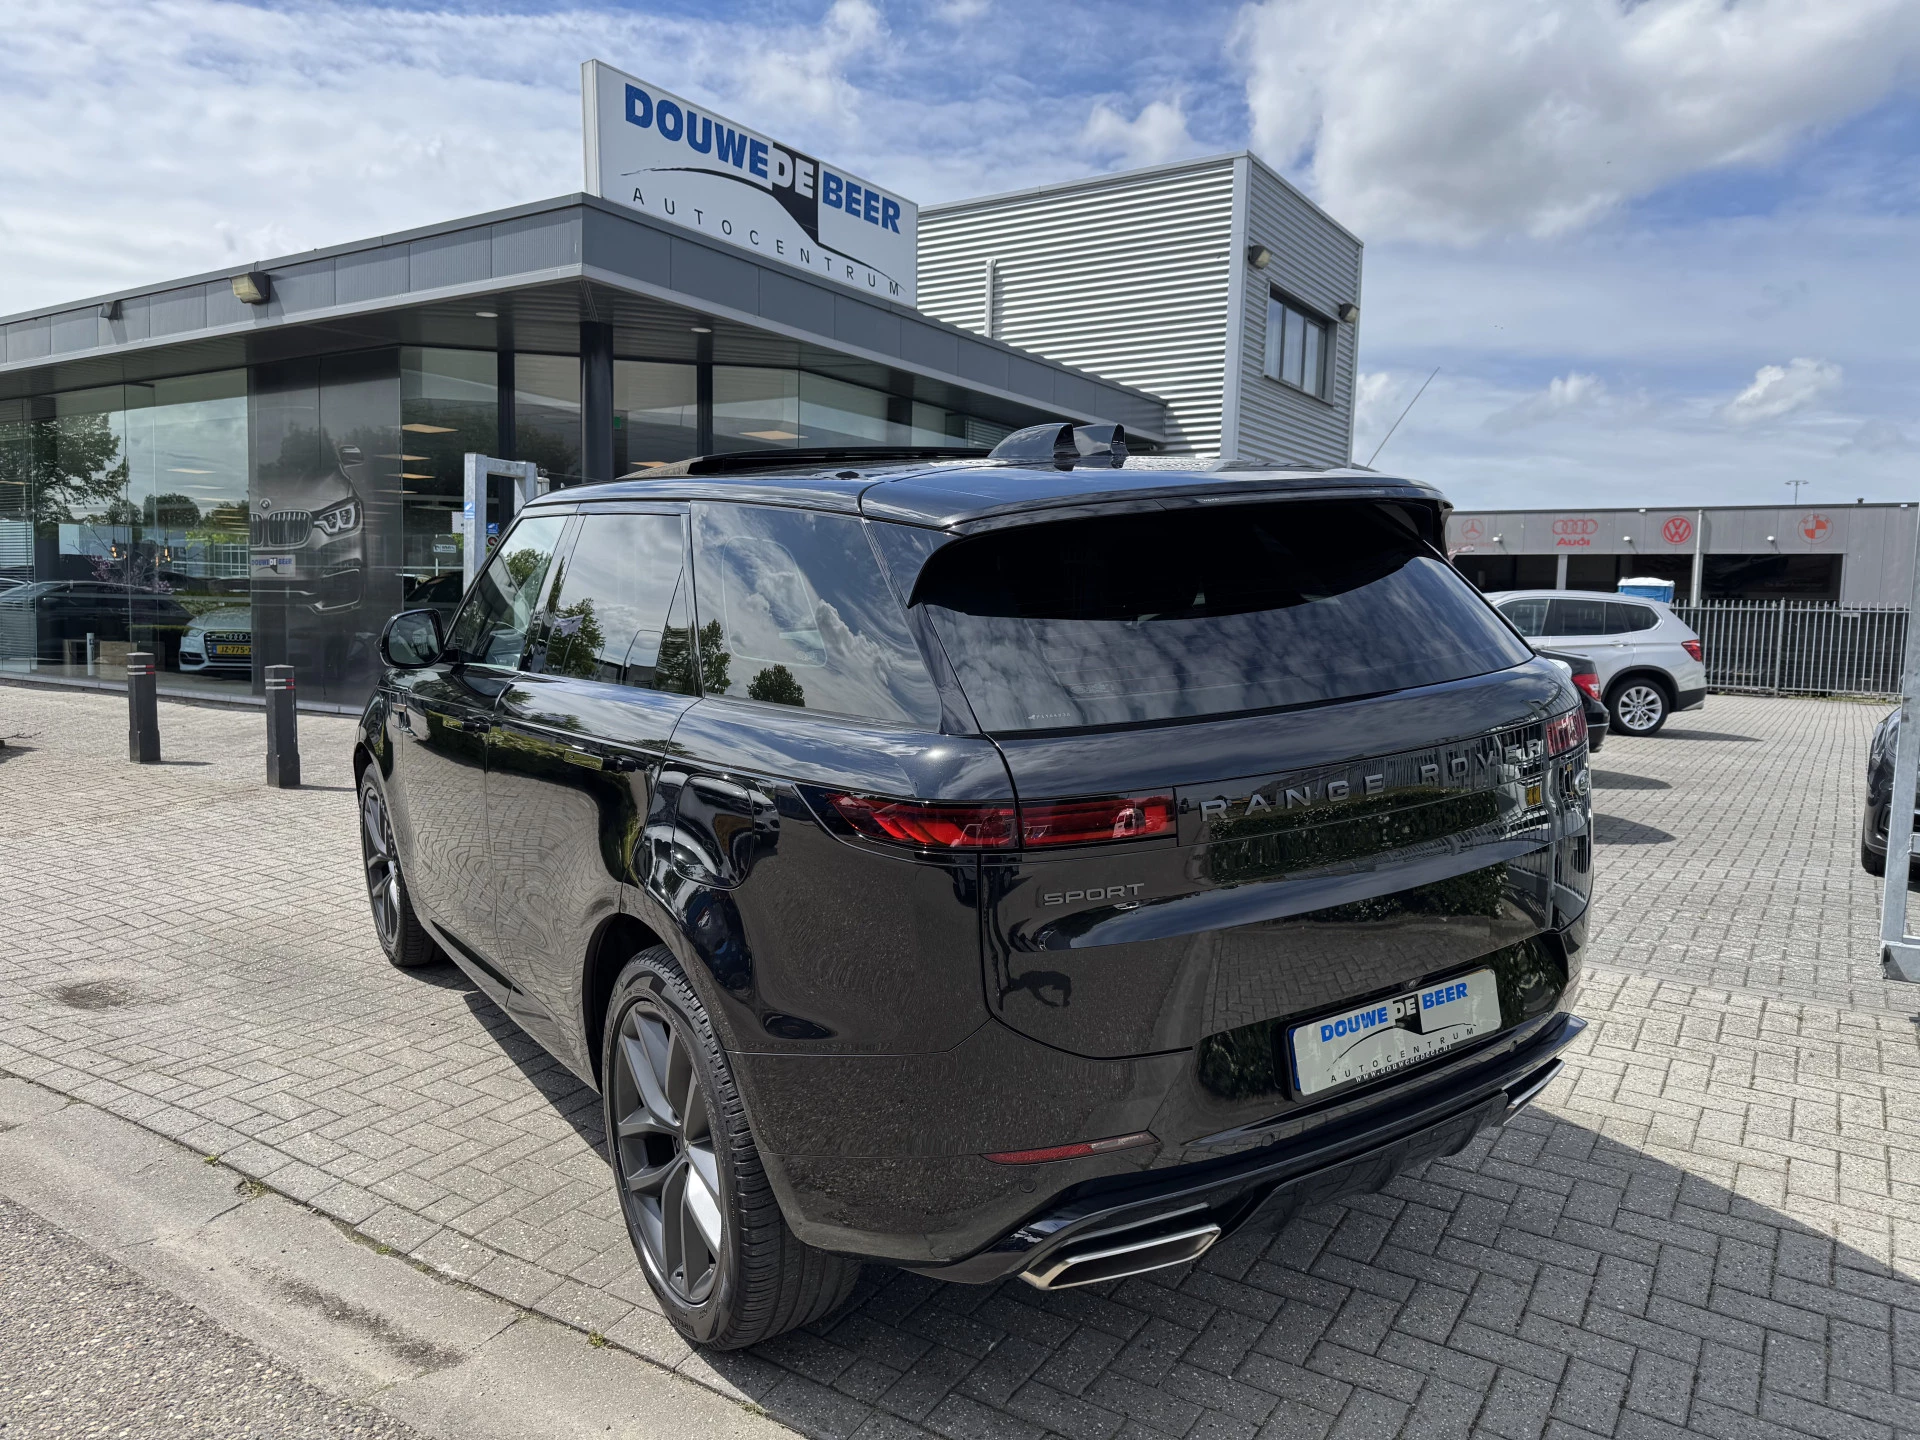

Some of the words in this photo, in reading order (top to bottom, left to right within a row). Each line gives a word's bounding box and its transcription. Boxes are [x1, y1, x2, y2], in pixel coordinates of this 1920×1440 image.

[625, 83, 769, 180] DOUWE
[772, 148, 814, 200] DE
[822, 170, 901, 235] BEER
[633, 187, 899, 296] AUTOCENTRUM
[1556, 537, 1591, 546] Audi
[1201, 774, 1385, 822] RANGE
[1421, 738, 1543, 784] ROVER
[1044, 883, 1145, 906] SPORT
[1320, 1006, 1388, 1043] DOUWE
[1394, 997, 1417, 1021] DE
[1422, 982, 1468, 1010] BEER
[1331, 1028, 1474, 1082] AUTOCENTRUM
